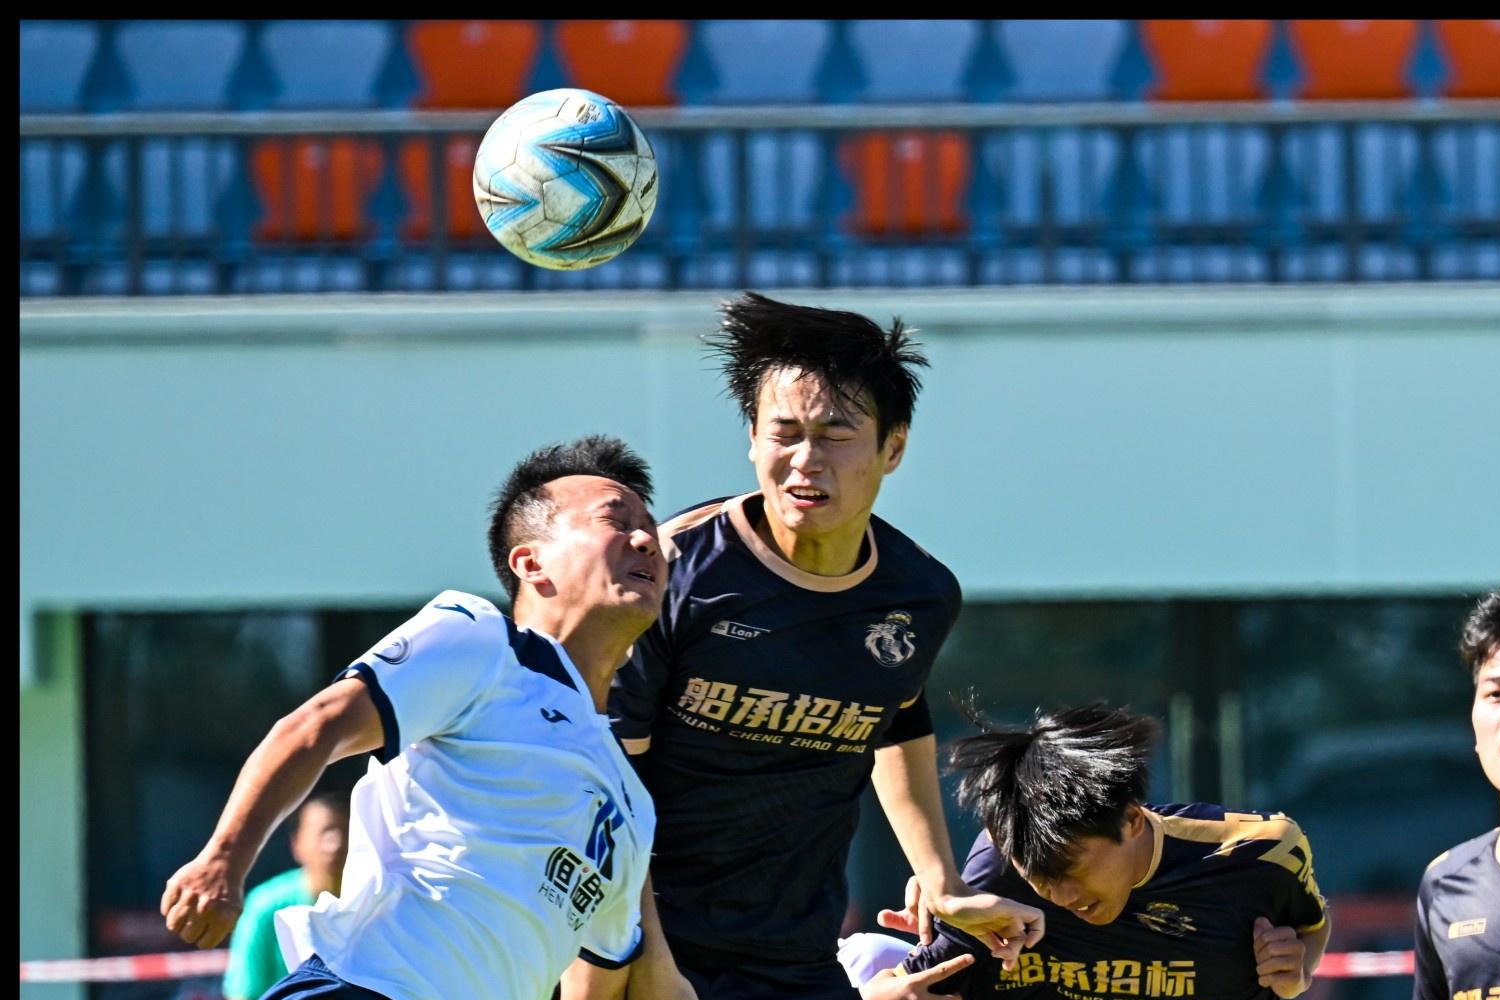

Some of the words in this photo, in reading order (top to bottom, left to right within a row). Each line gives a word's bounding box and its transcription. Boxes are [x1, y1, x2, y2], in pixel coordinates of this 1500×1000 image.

[679, 677, 885, 741] 船承招标
[729, 729, 784, 745] CHENG
